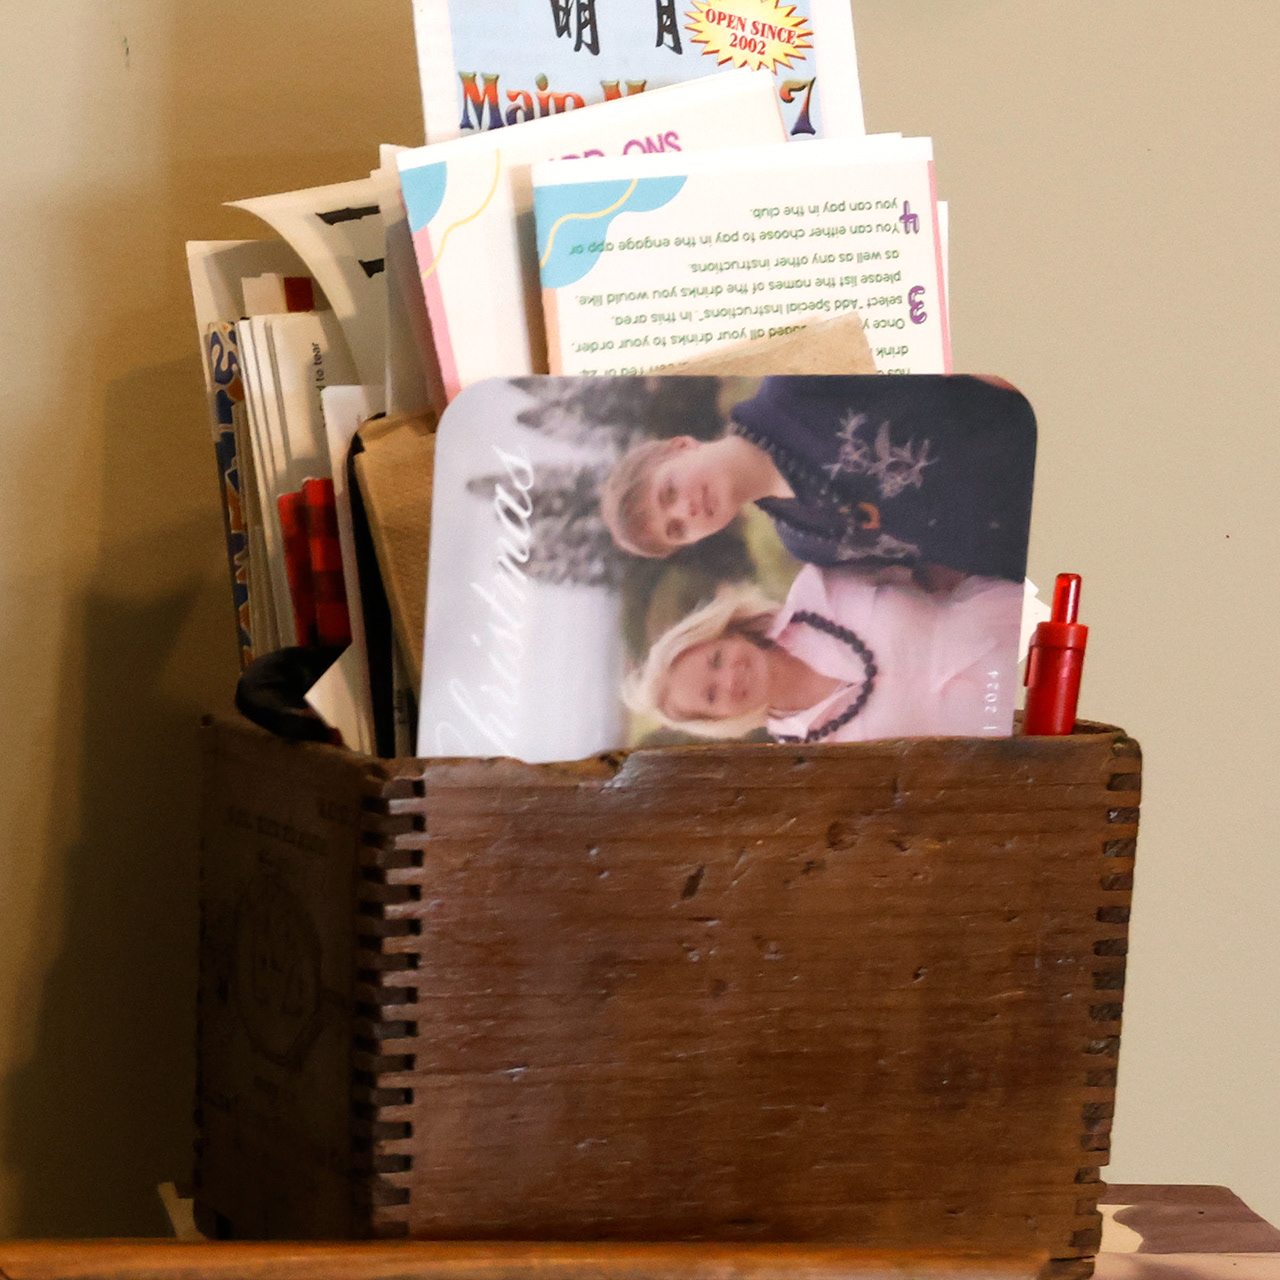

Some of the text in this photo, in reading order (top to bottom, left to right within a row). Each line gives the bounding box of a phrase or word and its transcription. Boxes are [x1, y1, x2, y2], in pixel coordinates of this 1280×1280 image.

[704, 8, 798, 46] OPEN SINCE
[729, 33, 767, 56] 2002
[823, 201, 845, 212] pay
[850, 201, 872, 211] can
[876, 197, 898, 210] you
[784, 207, 804, 217] the
[808, 205, 819, 217] in
[899, 200, 920, 234] 4
[809, 226, 845, 238] either
[850, 225, 872, 234] can
[876, 223, 899, 234] You
[700, 235, 712, 245] in
[716, 231, 738, 243] pay
[742, 234, 756, 243] to
[760, 229, 805, 241] choose
[618, 237, 671, 251] engage
[675, 237, 696, 246] the
[812, 253, 835, 264] any
[839, 254, 853, 262] as
[856, 251, 881, 263] well
[885, 250, 899, 259] as
[774, 257, 808, 269] other
[815, 277, 836, 287] the
[840, 275, 857, 287] list
[861, 270, 901, 283] please
[727, 283, 749, 295] the
[752, 282, 765, 295] of
[769, 279, 811, 290] names
[653, 287, 677, 299] you
[681, 286, 723, 298] drinks
[607, 292, 648, 305] would
[867, 295, 902, 304] select
[908, 285, 927, 324] 3
[787, 299, 830, 311] Special
[650, 313, 676, 324] this
[874, 318, 905, 329] Once
[670, 332, 713, 344] drinks
[717, 328, 747, 339] your
[618, 336, 648, 349] your
[654, 337, 666, 347] to
